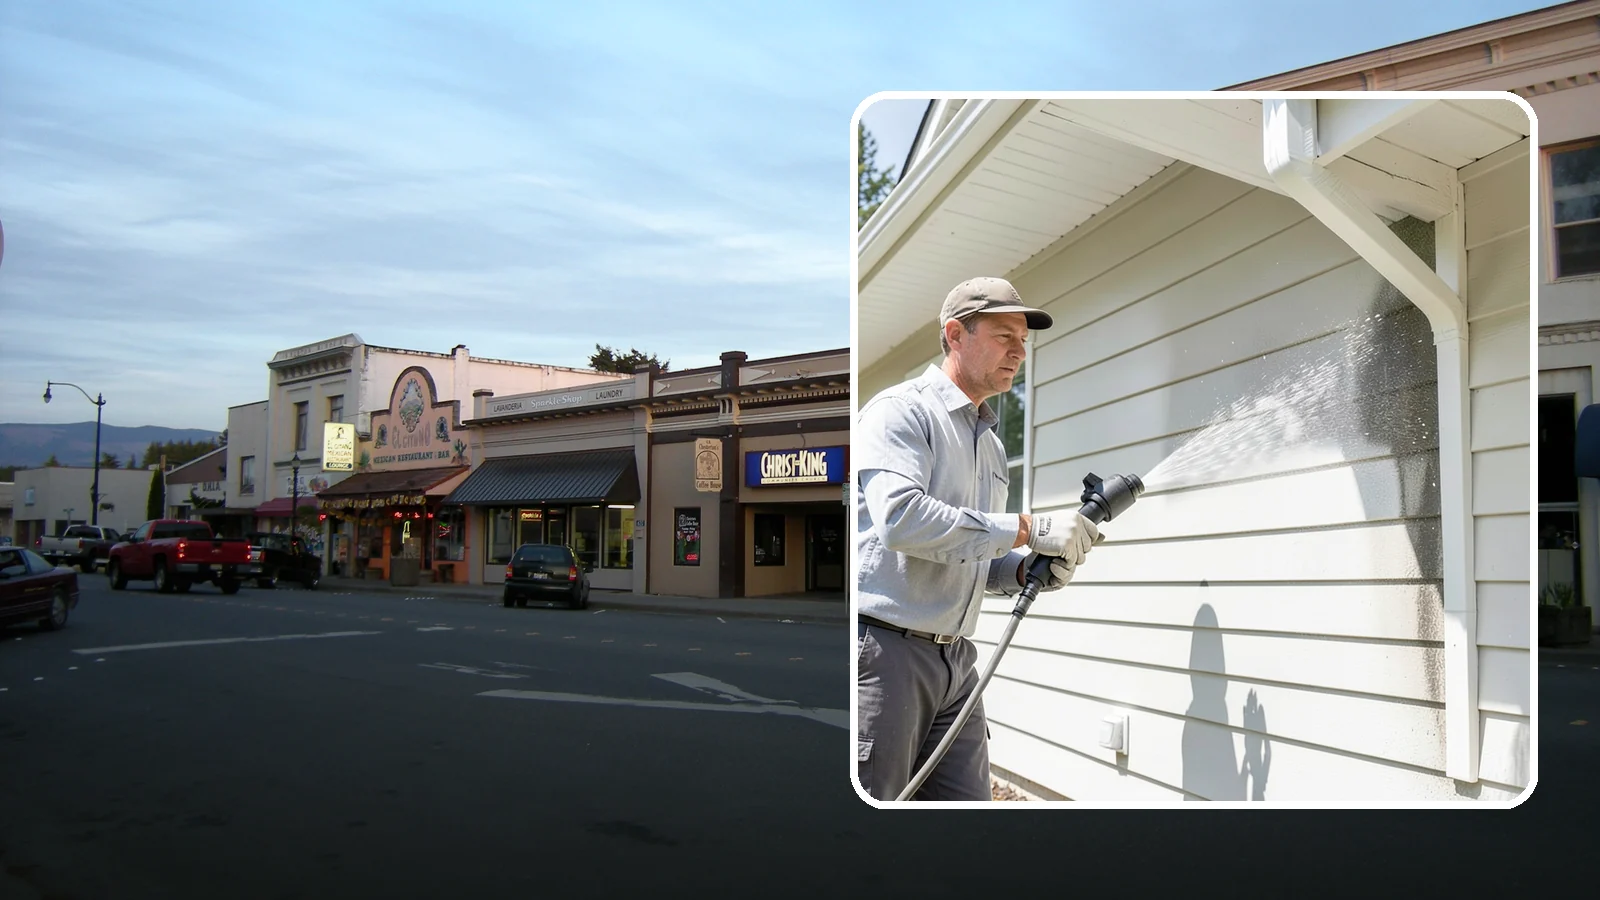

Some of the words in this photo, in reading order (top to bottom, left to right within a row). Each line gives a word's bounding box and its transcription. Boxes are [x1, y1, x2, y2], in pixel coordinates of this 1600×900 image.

[562, 394, 582, 405] Shop
[596, 388, 623, 400] LAUNDRY
[493, 402, 522, 412] LAVANDERIA
[373, 454, 396, 464] MEXICAN
[397, 451, 433, 462] RESTAURANT
[437, 449, 450, 459] BAR
[761, 452, 797, 478] CHRIST
[799, 450, 827, 476] KING
